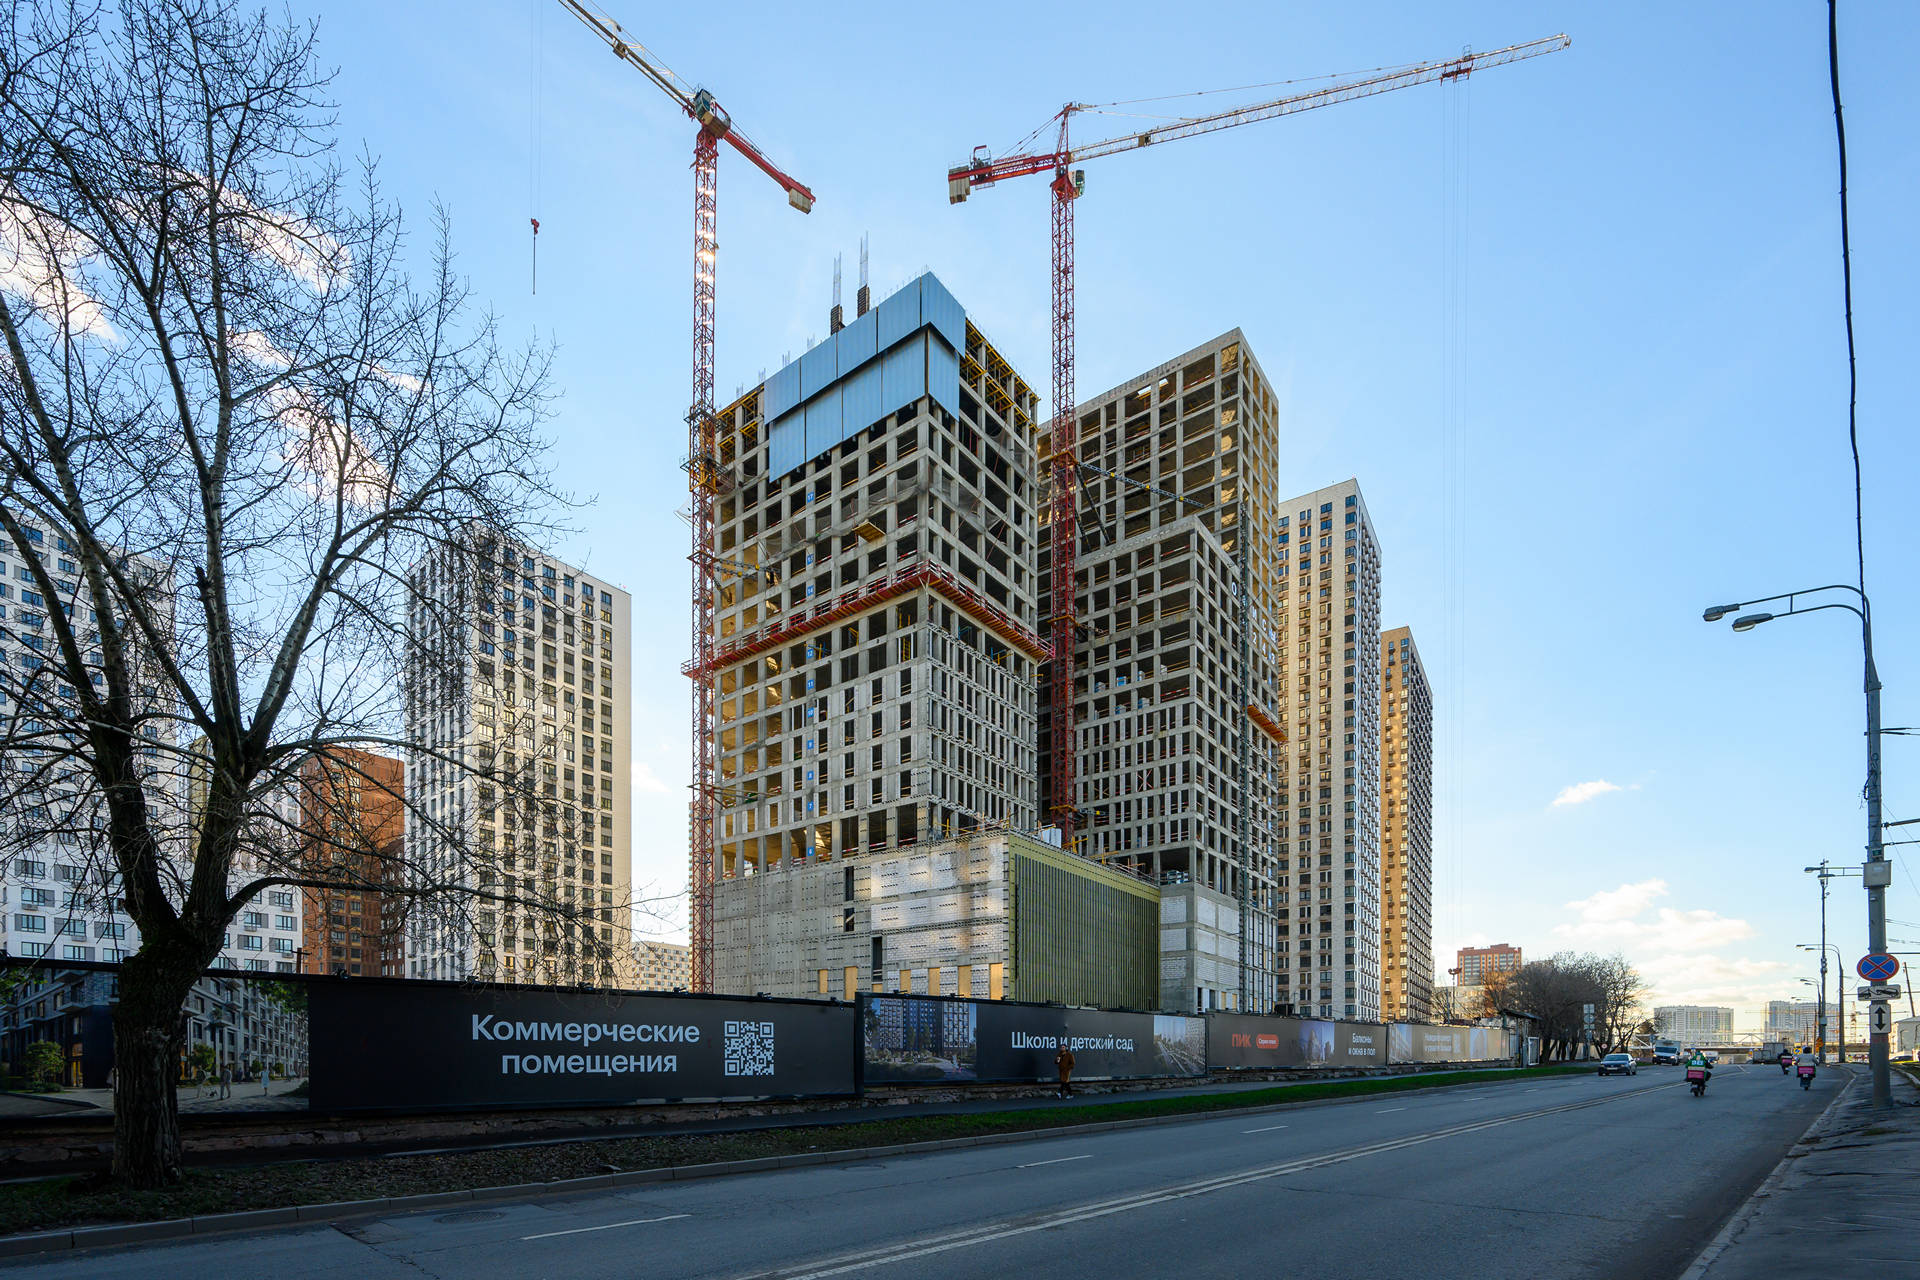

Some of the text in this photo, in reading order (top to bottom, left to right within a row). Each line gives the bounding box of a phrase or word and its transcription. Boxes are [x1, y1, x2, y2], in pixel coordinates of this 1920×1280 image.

[471, 1013, 700, 1047] Коммерческие
[1231, 1033, 1252, 1048] ПИК
[1011, 1031, 1057, 1049] Школа
[1070, 1034, 1114, 1052] детский
[1115, 1038, 1134, 1052] сад
[501, 1054, 677, 1077] помещения
